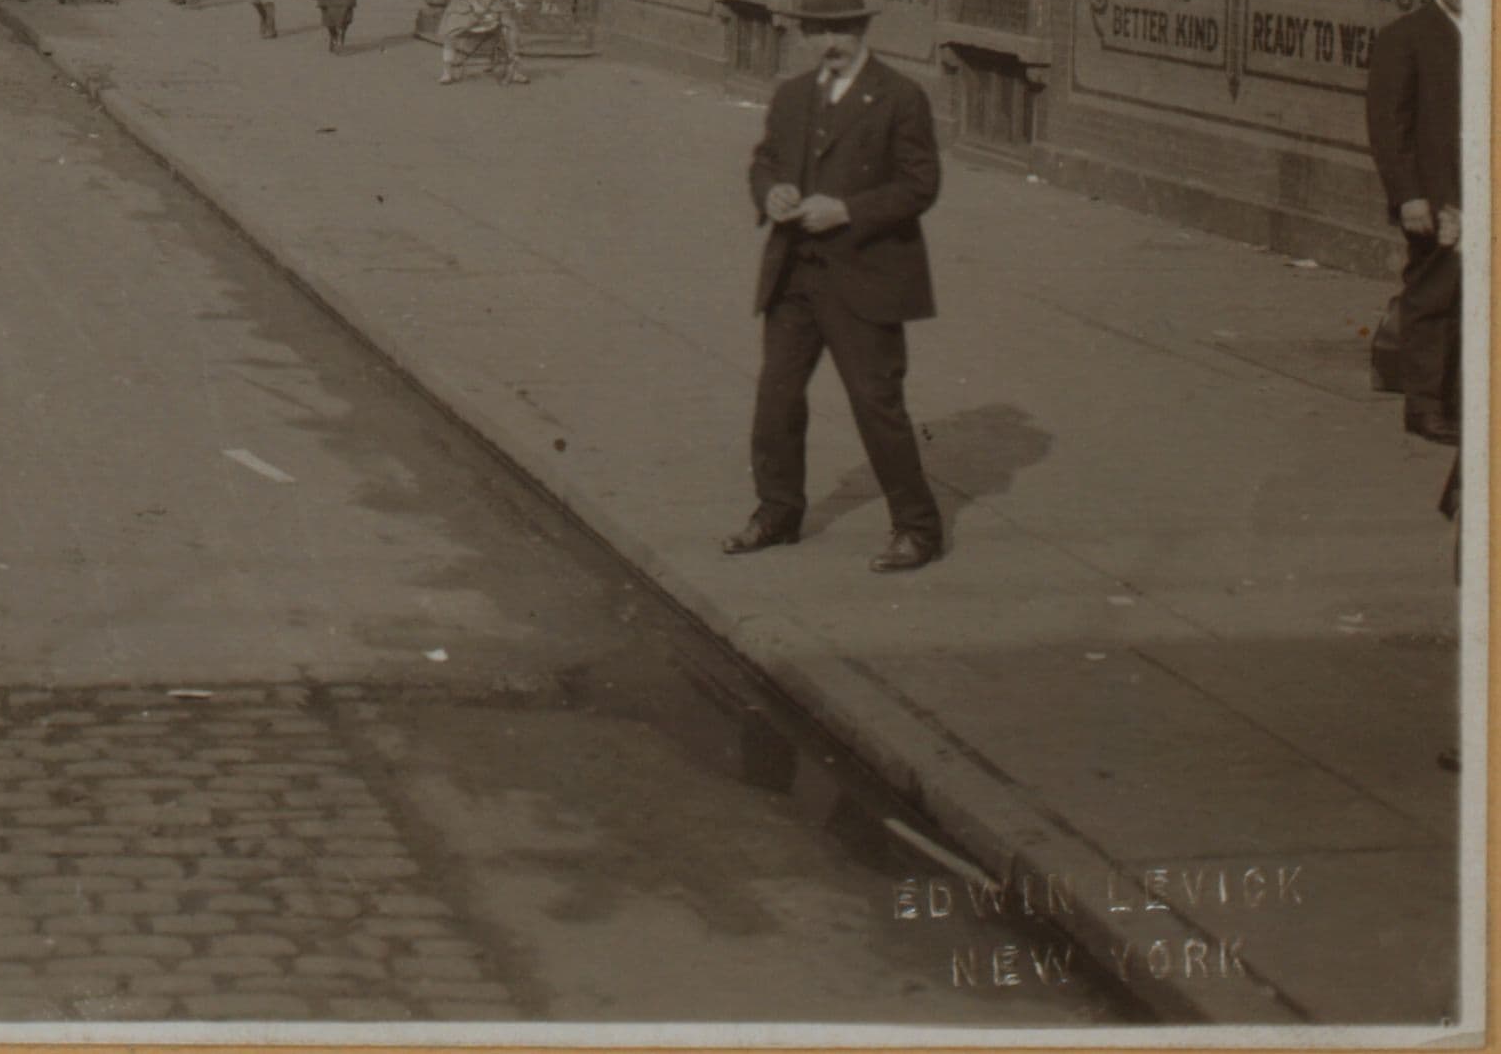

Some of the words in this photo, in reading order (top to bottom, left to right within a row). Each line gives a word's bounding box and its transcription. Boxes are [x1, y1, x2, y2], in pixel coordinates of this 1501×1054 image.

[1112, 4, 1168, 44] BETTER
[1175, 12, 1219, 53] KIND
[1253, 11, 1310, 59] READY
[1313, 17, 1334, 63] TO
